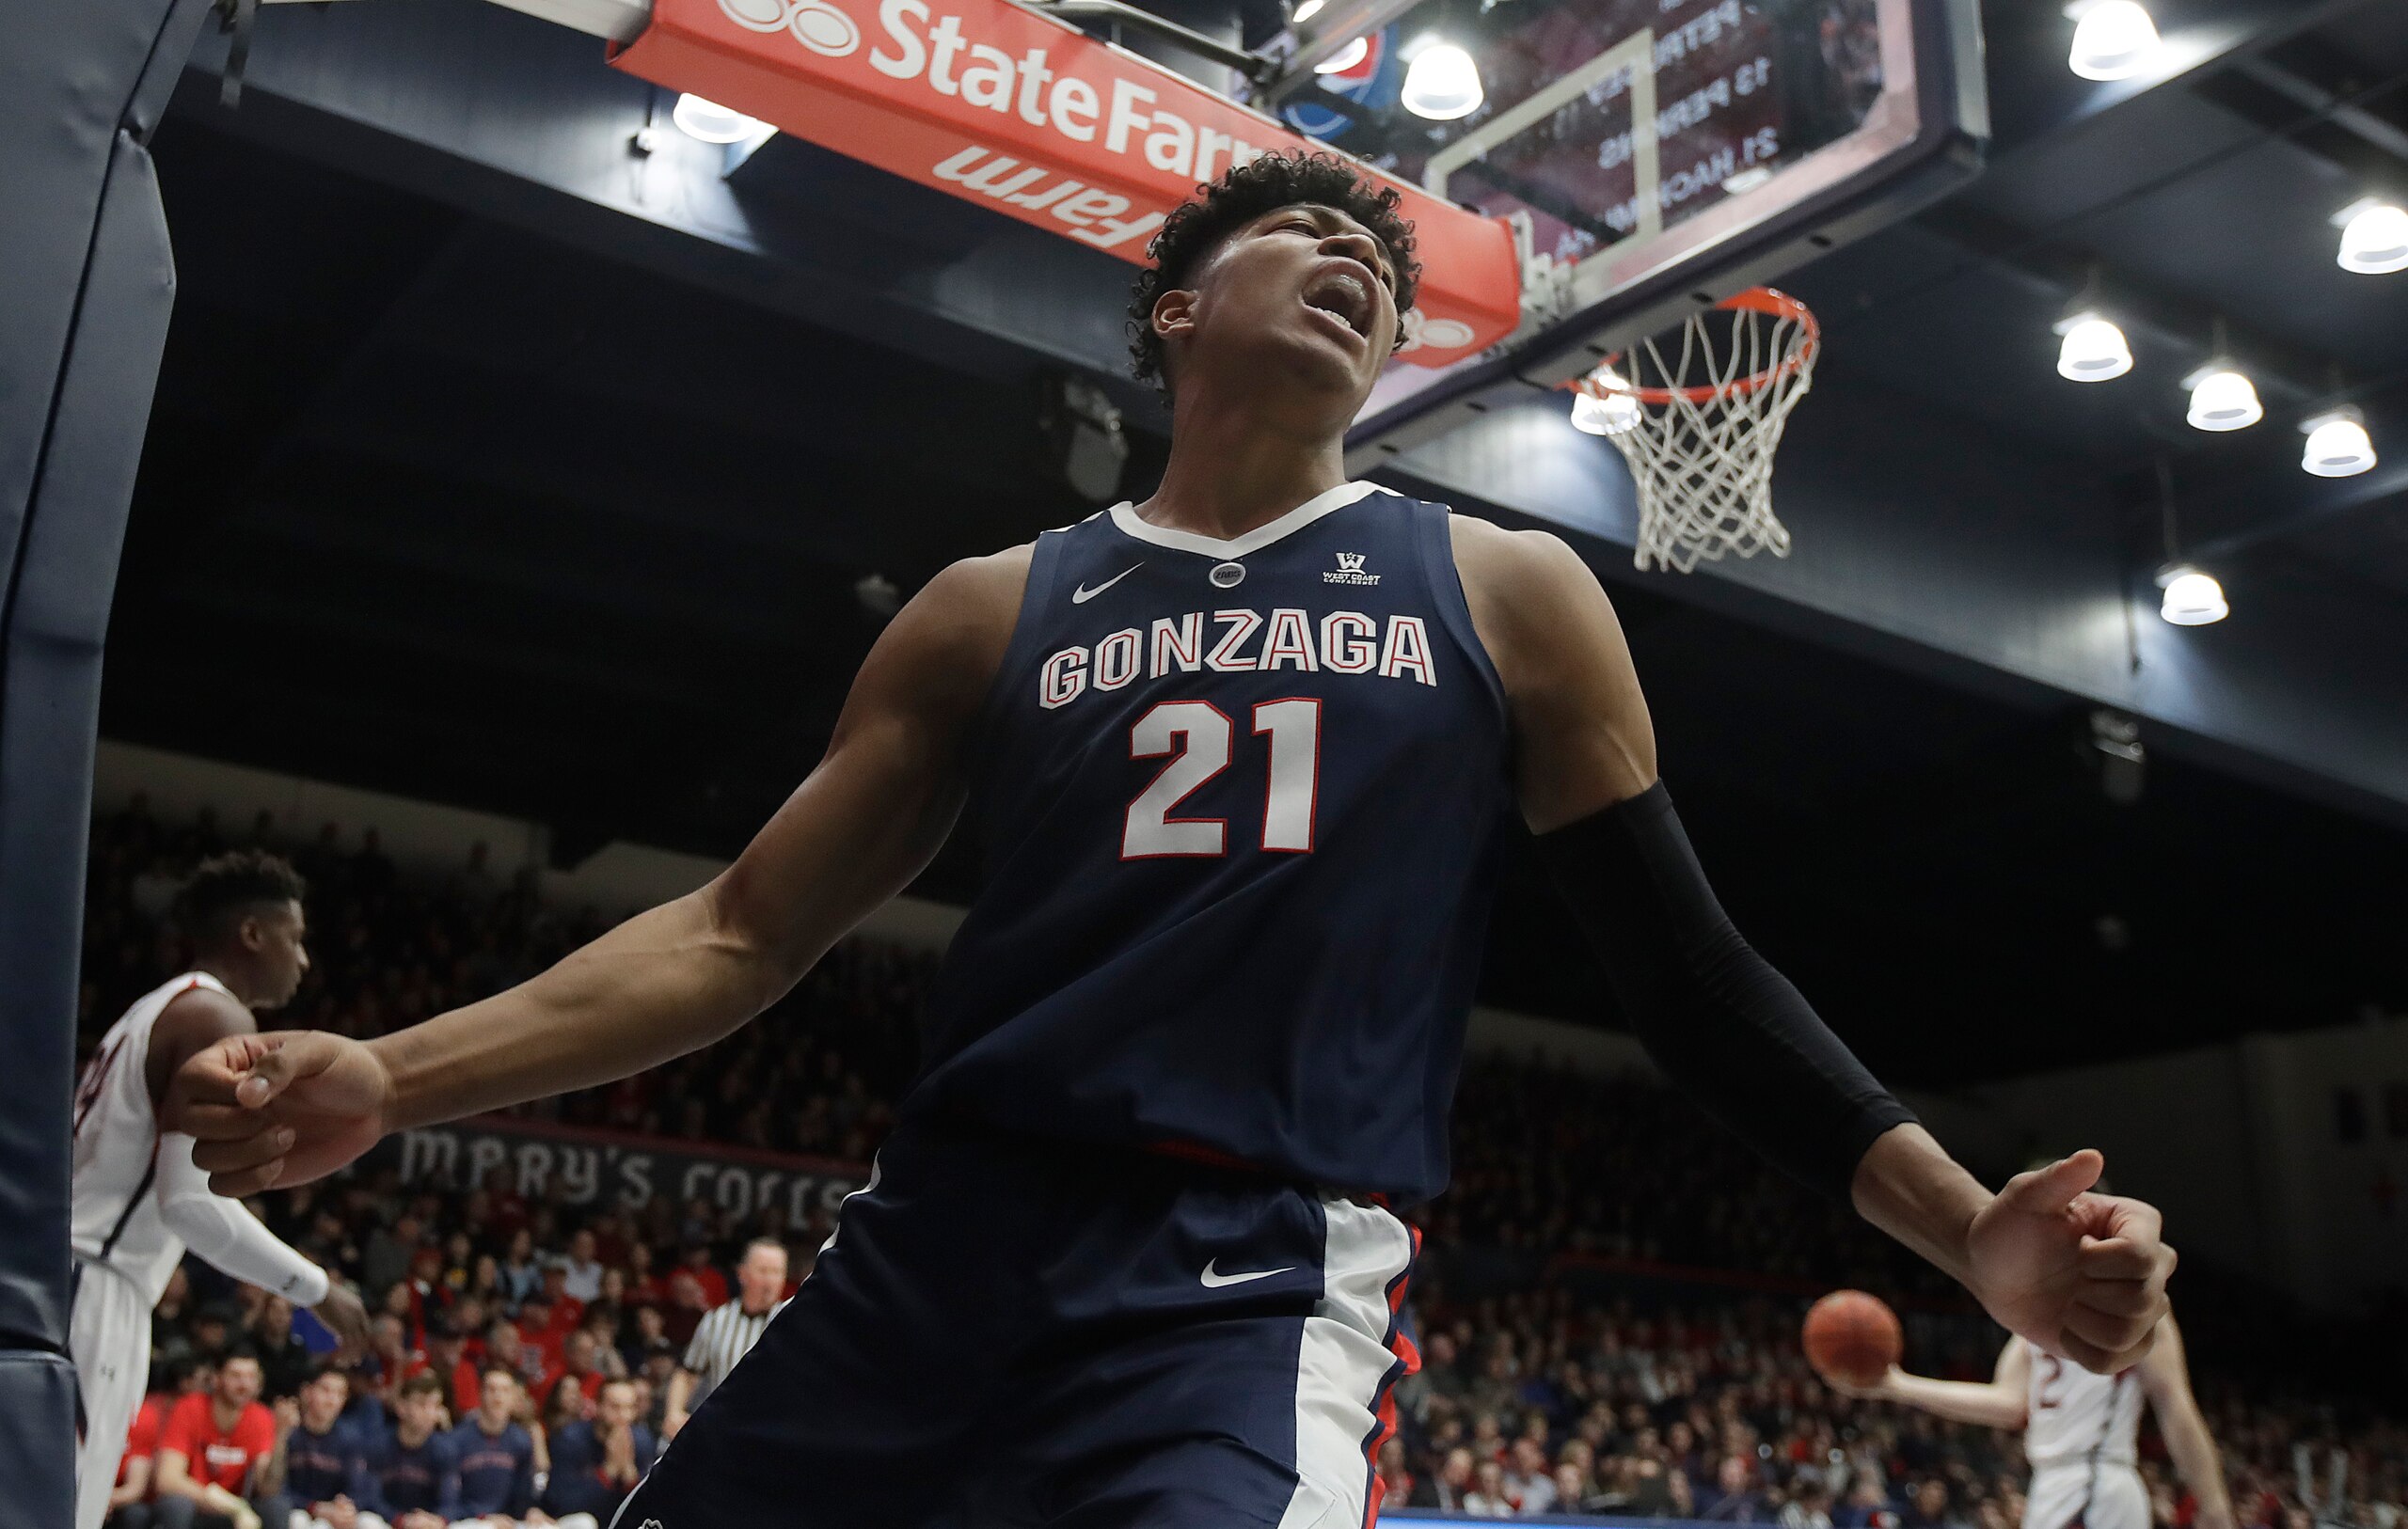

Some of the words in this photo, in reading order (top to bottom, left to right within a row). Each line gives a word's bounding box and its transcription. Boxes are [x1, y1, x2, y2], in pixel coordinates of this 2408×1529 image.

[932, 145, 1168, 248] Farm
[1323, 572, 1350, 580] WEST
[1351, 574, 1381, 582] COAST
[1039, 608, 1437, 709] GONZAGA
[1118, 697, 1323, 861] 21
